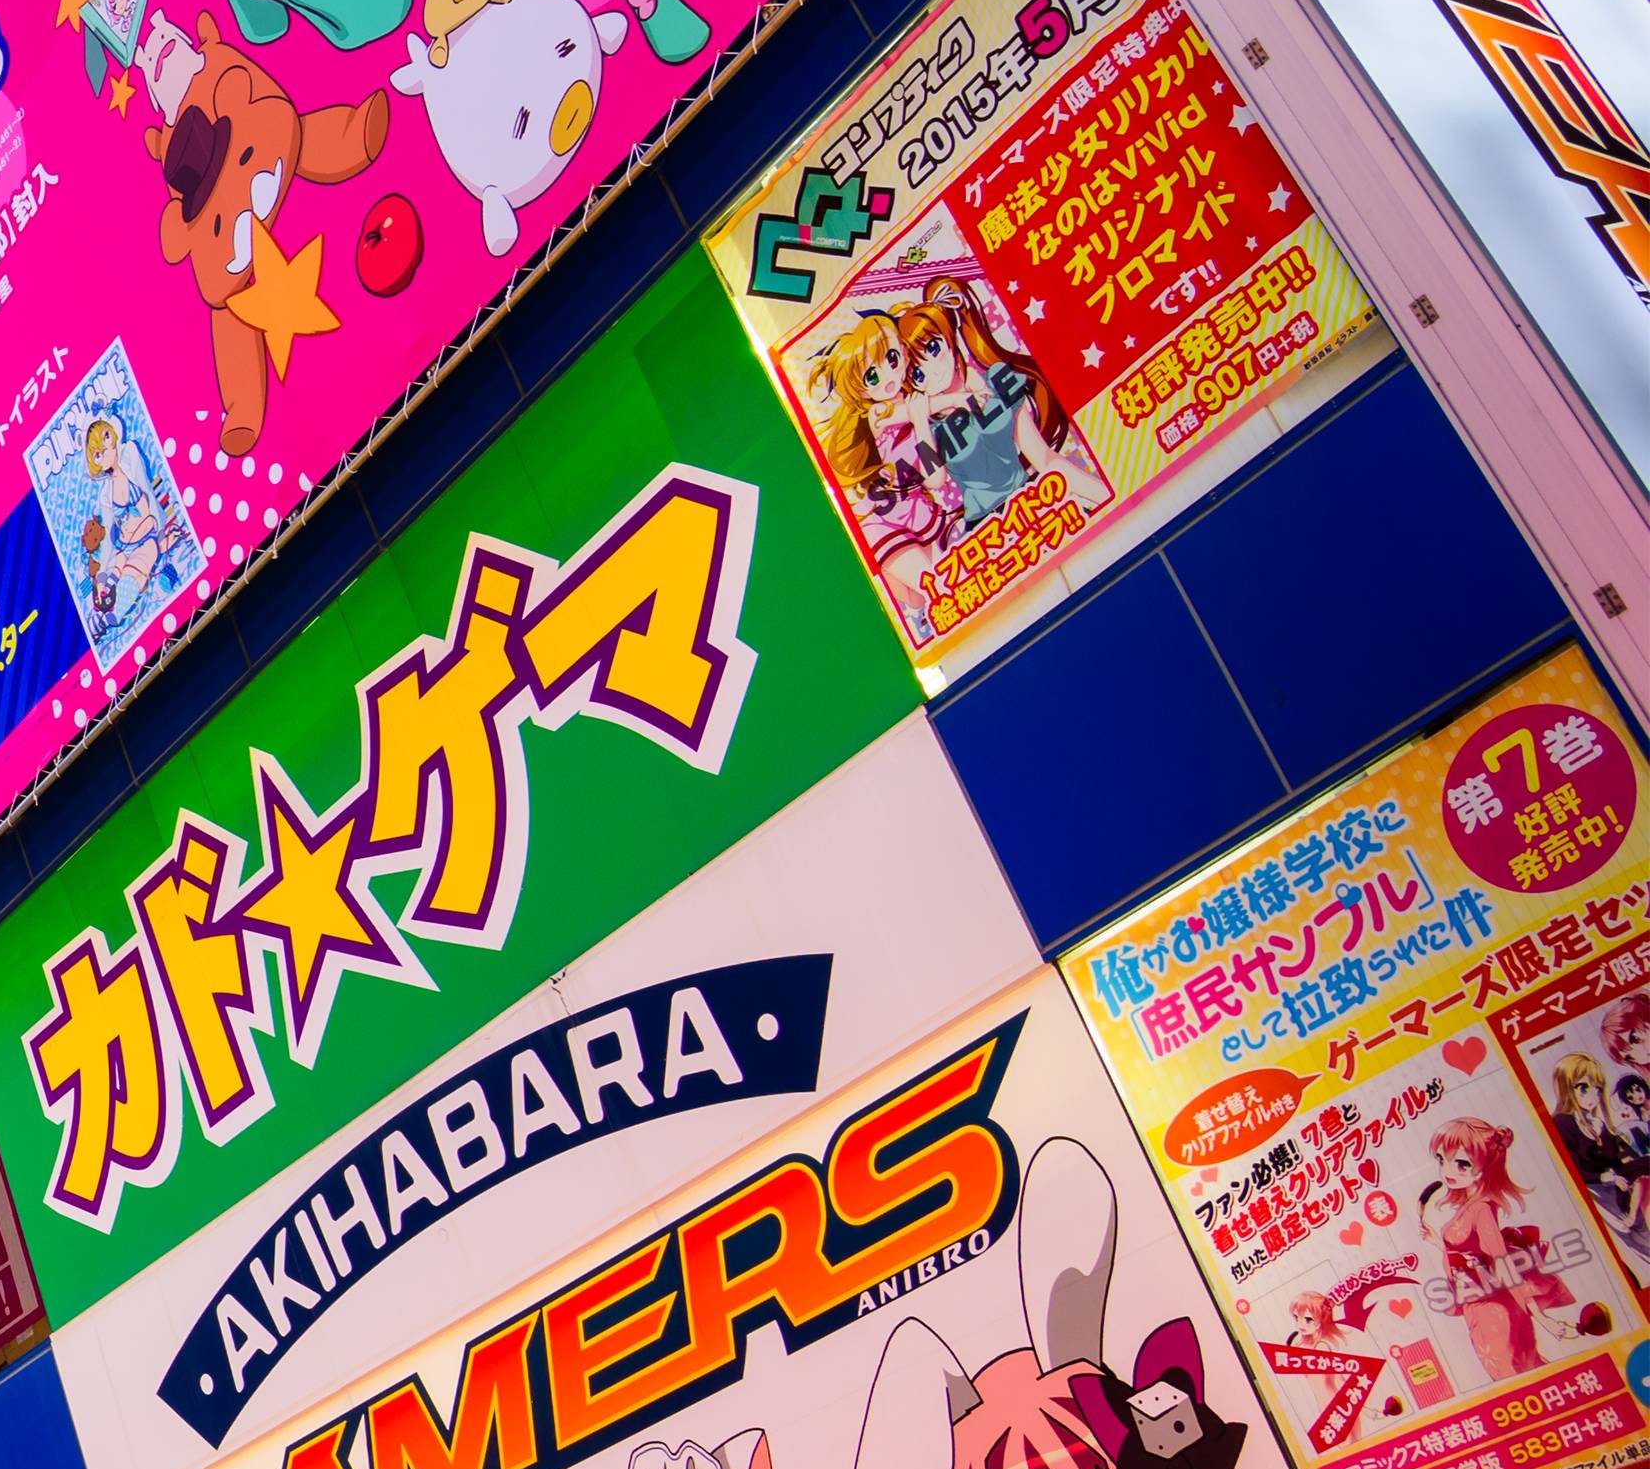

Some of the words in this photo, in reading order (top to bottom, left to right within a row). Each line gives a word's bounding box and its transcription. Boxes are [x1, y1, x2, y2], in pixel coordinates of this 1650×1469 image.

[824, 14, 978, 187] コンプティーク
[977, 24, 1215, 257] 魔法少女リリカル
[1022, 97, 1211, 271] なのはViVid
[1061, 143, 1220, 293] オリジナル
[867, 362, 1030, 521] SAMPLE
[1444, 706, 1612, 837] 第7巻
[1508, 803, 1626, 894] 発売中!
[1512, 781, 1585, 841] 好評
[1088, 798, 1406, 1023] 俺がお嬢様学校に
[1218, 889, 1499, 1067] として拉致られた件
[215, 982, 746, 1397] AKIHABARA
[856, 1224, 996, 1322] ANIBRO
[1424, 1227, 1595, 1319] SAMPLE
